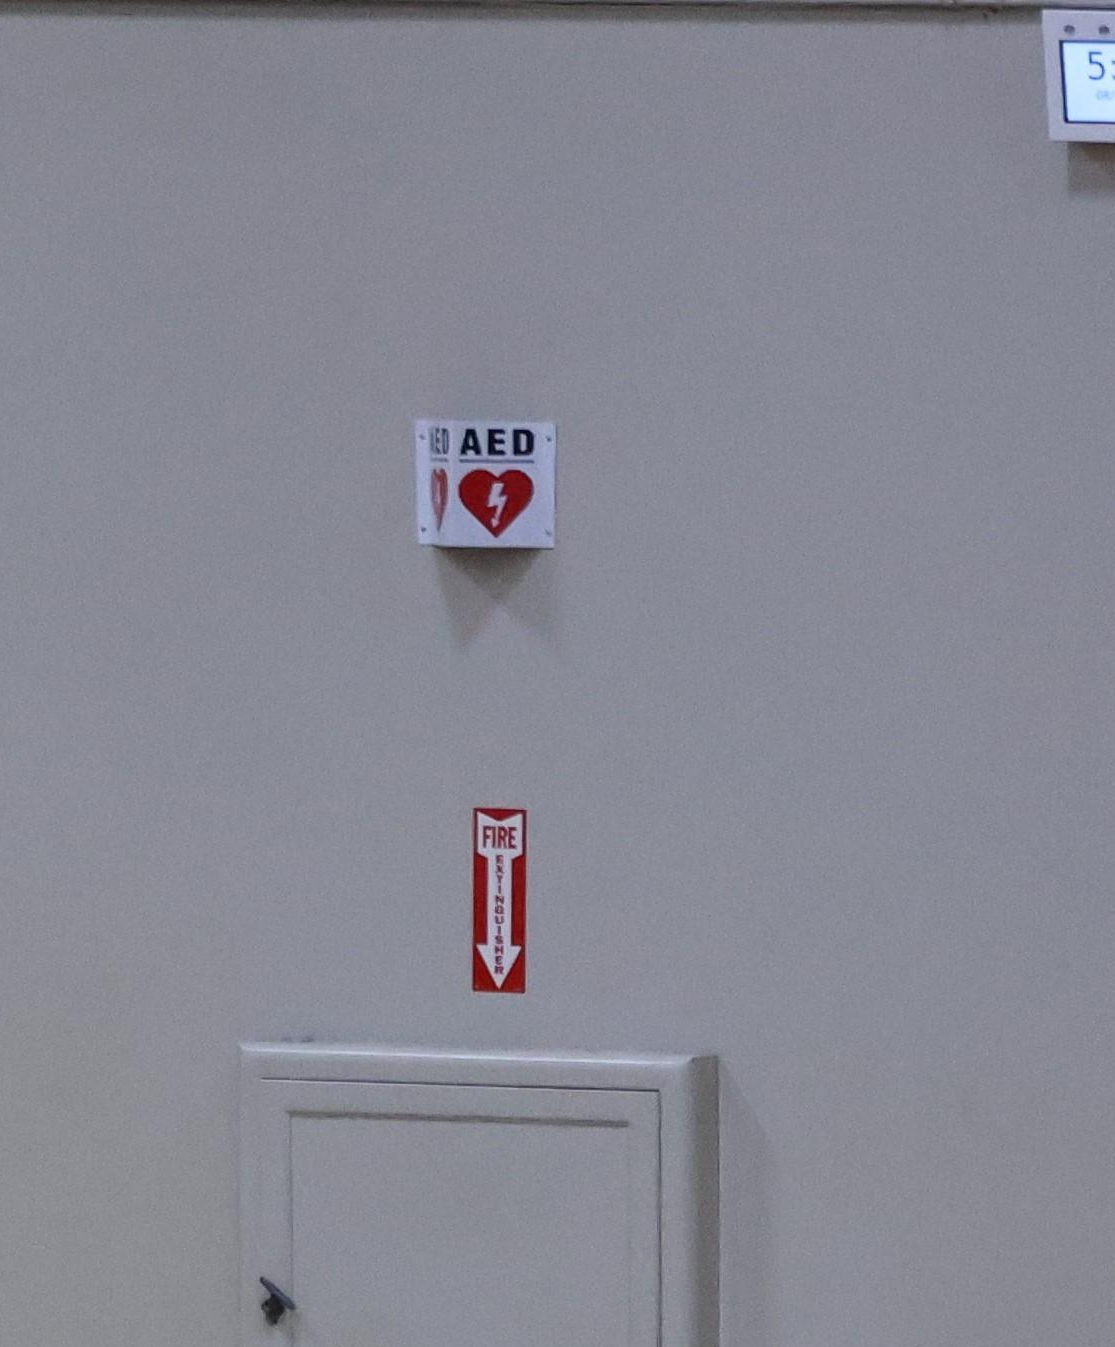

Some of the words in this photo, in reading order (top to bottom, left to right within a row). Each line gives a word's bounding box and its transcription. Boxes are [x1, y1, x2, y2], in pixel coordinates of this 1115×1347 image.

[460, 428, 535, 456] AED
[483, 826, 517, 849] FIRE
[494, 854, 505, 975] EXTINGUISHER
